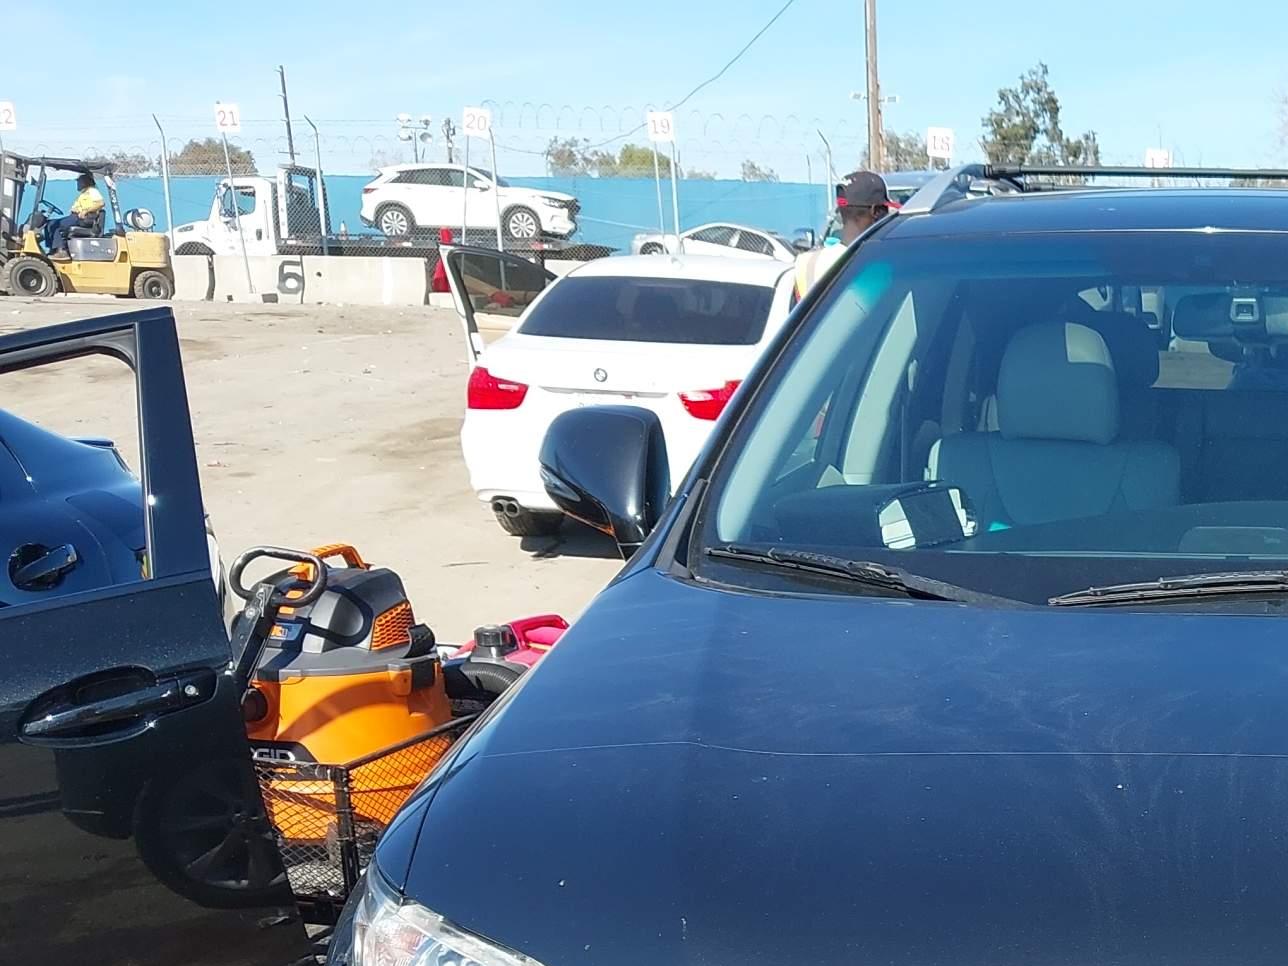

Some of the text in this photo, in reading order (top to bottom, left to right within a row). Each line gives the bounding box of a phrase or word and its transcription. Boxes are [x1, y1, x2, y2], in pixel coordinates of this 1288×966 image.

[0, 108, 14, 125] 2
[217, 110, 238, 127] 21
[465, 113, 487, 131] 20
[651, 118, 670, 135] 19
[278, 260, 304, 294] 6
